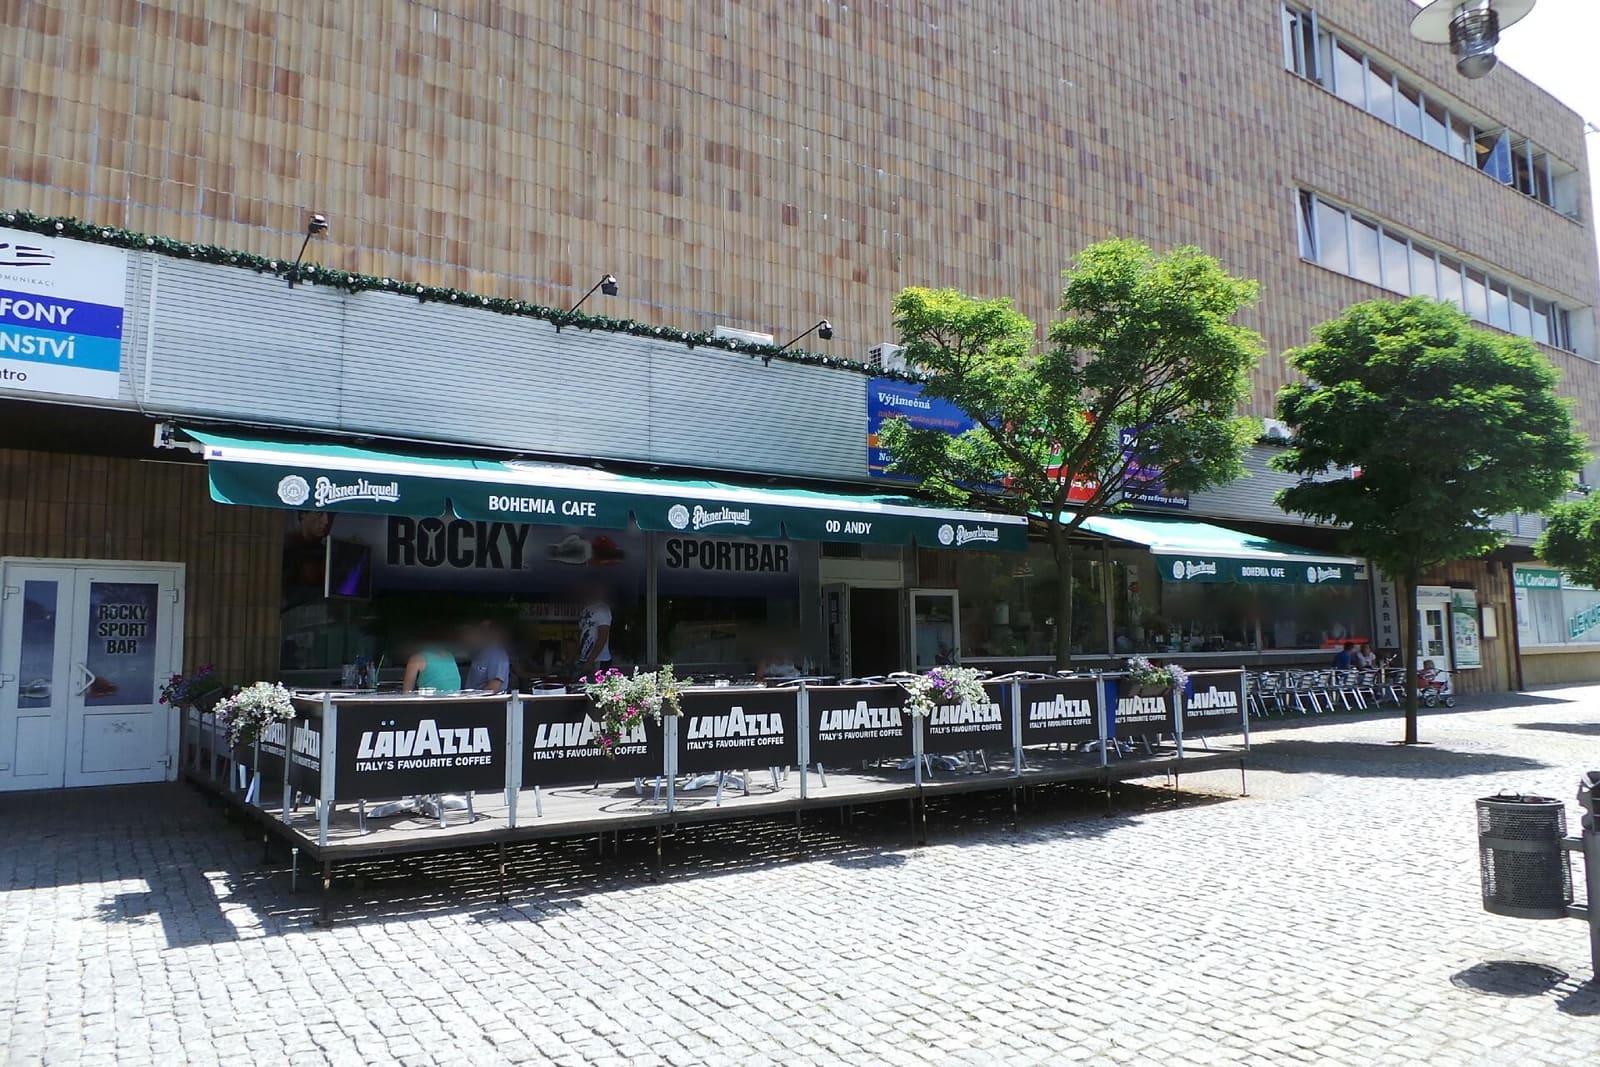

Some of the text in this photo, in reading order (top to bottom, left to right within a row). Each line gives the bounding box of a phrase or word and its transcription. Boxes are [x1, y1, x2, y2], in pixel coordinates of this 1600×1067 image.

[314, 476, 399, 507] Pilsner Urquell
[488, 495, 597, 517] BOHEMIA CAFE
[693, 504, 751, 530] Pilsner Urquell
[826, 520, 872, 535] OD ANDY
[386, 516, 530, 569] ROCKY
[666, 539, 789, 573] SPORTBAR
[1271, 567, 1285, 578] CAFE
[99, 605, 149, 620] ROCKY
[98, 622, 147, 637] SPORT
[107, 639, 137, 654] BAR
[1030, 694, 1092, 720] LAVAZZA
[687, 706, 784, 739] LAVAZZA
[819, 701, 902, 731] LAVAZZA
[819, 729, 902, 741] ITALY'S FAVOURITE COFFEE
[981, 723, 1002, 731] COFFEE
[687, 737, 784, 750] ITALY'S FAVOURITE COFFEE
[533, 750, 564, 760] ITALY'S
[615, 745, 647, 755] COFFEE
[356, 755, 492, 772] ITALY'S FAVOURITE COFFEE
